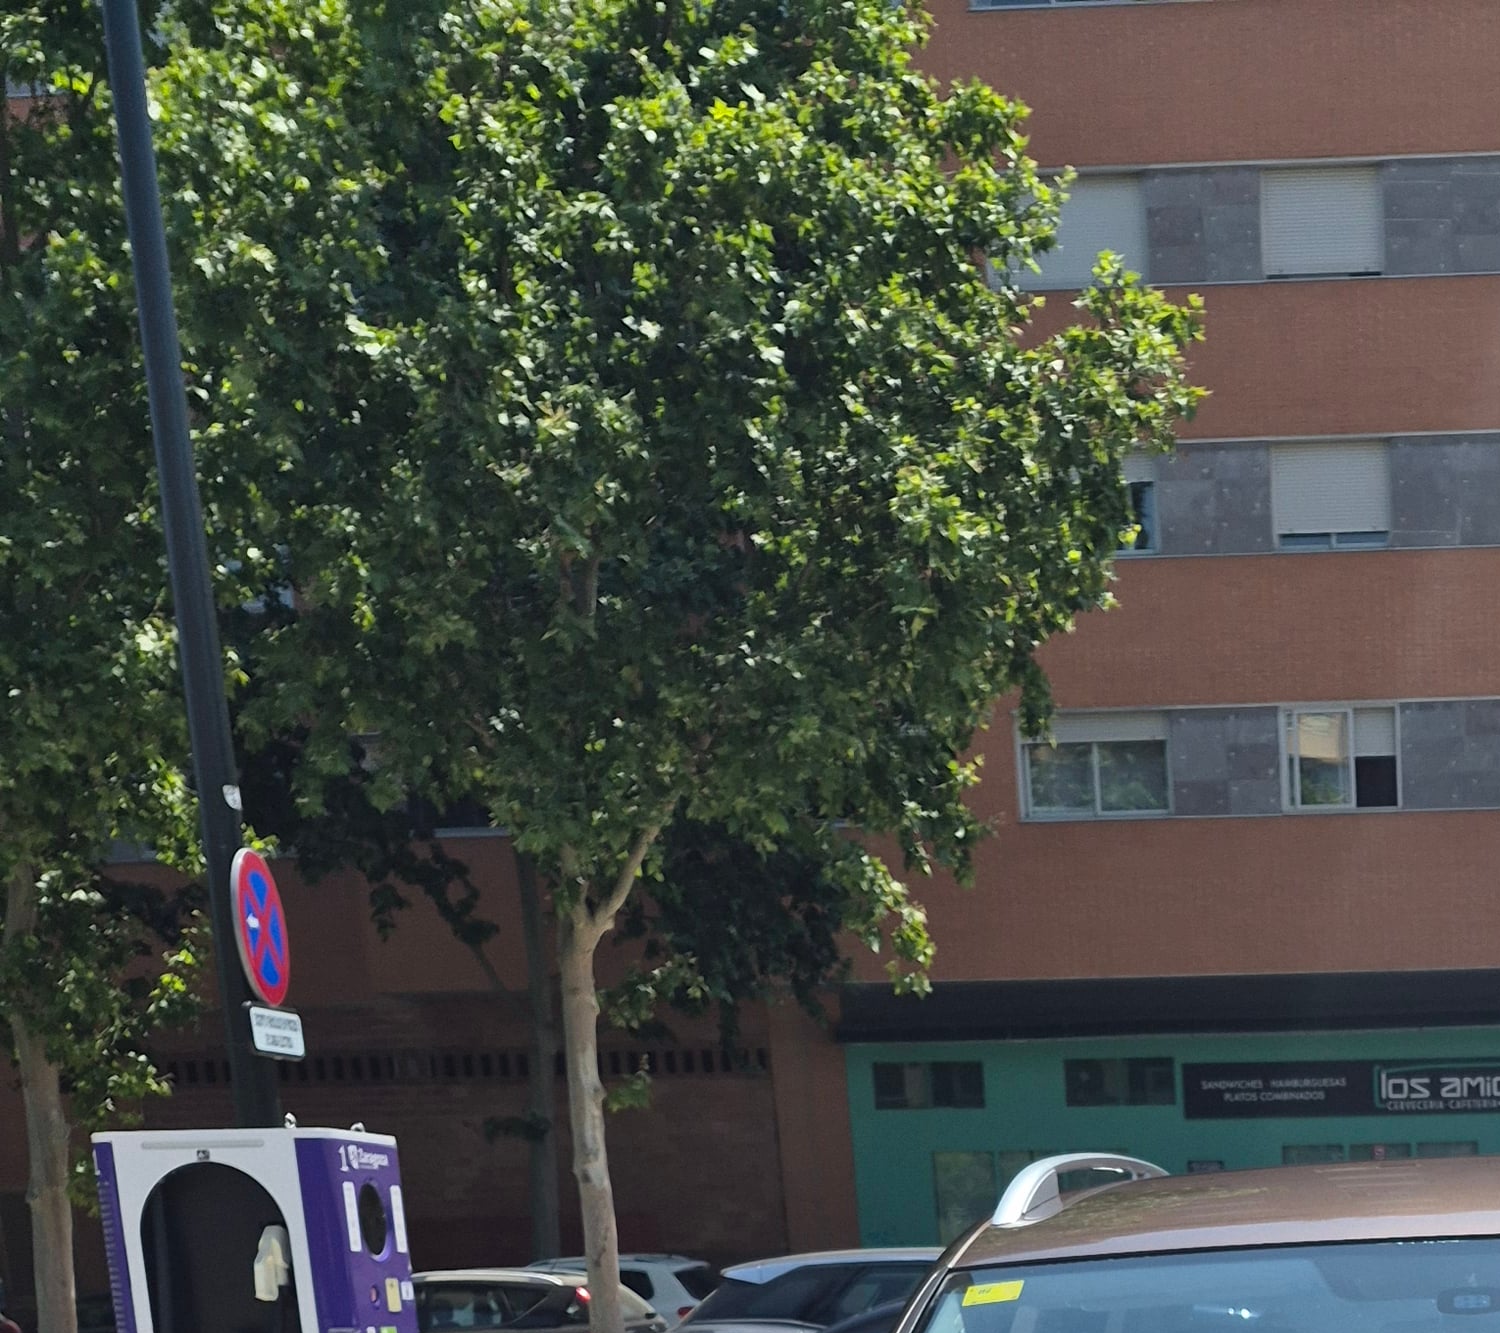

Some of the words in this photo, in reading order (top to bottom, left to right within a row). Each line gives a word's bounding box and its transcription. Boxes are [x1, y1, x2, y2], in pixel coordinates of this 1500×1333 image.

[1201, 1079, 1263, 1090] SANDWICHES
[1270, 1077, 1347, 1089] HAMBURGUESAS
[1381, 1072, 1430, 1099] los
[1223, 1092, 1258, 1103] PLATOS
[1260, 1090, 1326, 1102] COMBINADOS
[338, 1145, 349, 1172] 1
